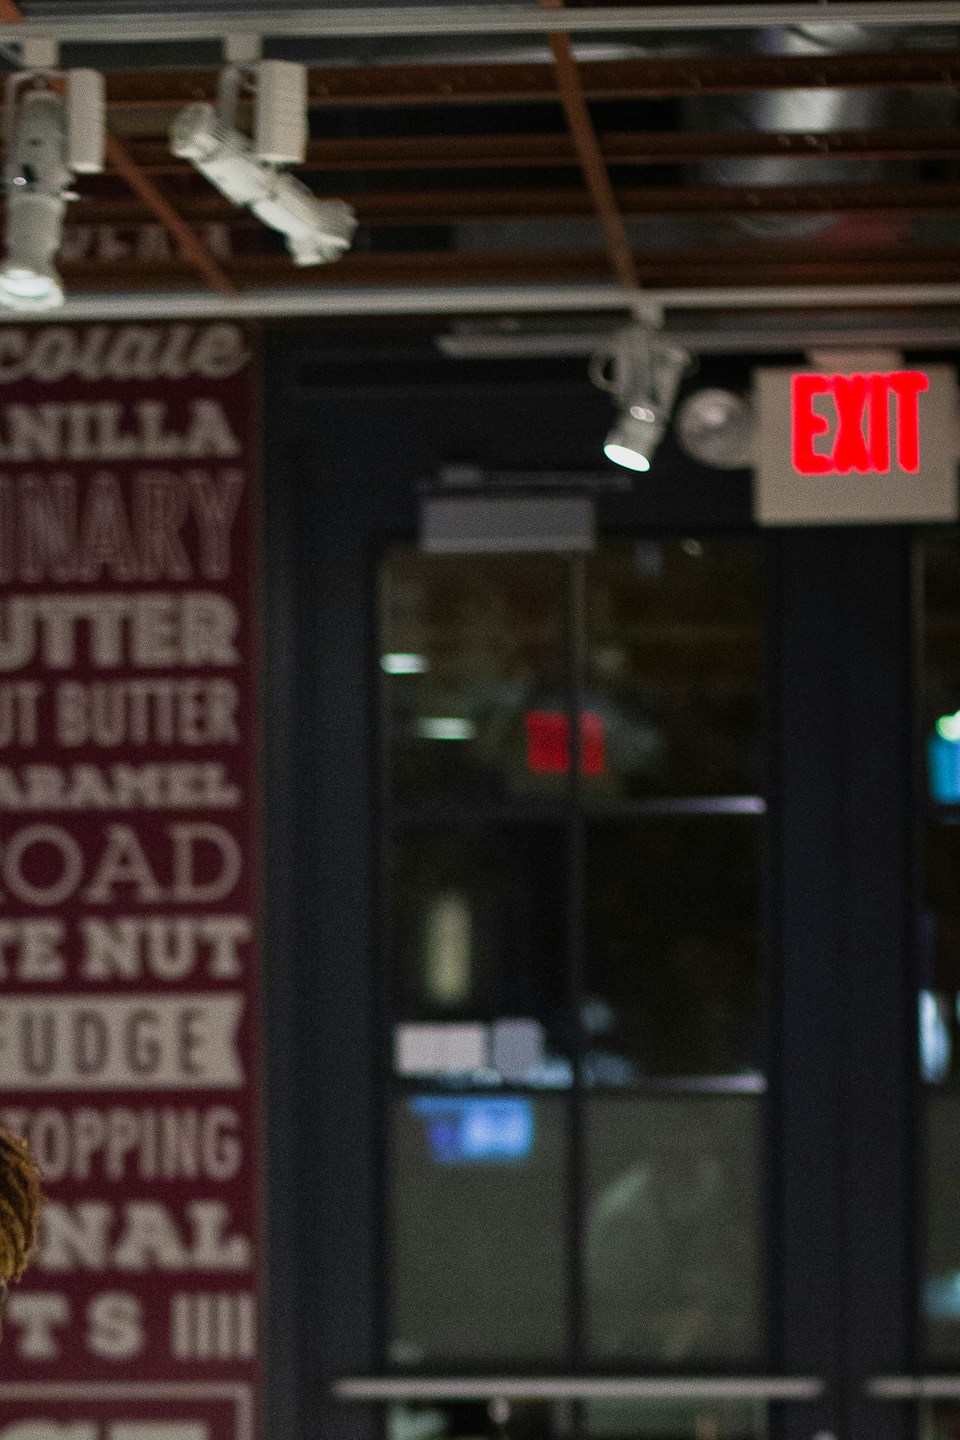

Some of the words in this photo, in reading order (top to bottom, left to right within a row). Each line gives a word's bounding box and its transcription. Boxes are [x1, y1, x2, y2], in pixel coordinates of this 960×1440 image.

[791, 370, 930, 476] EXIT
[57, 679, 239, 748] BUTTER
[80, 917, 251, 982] NUT
